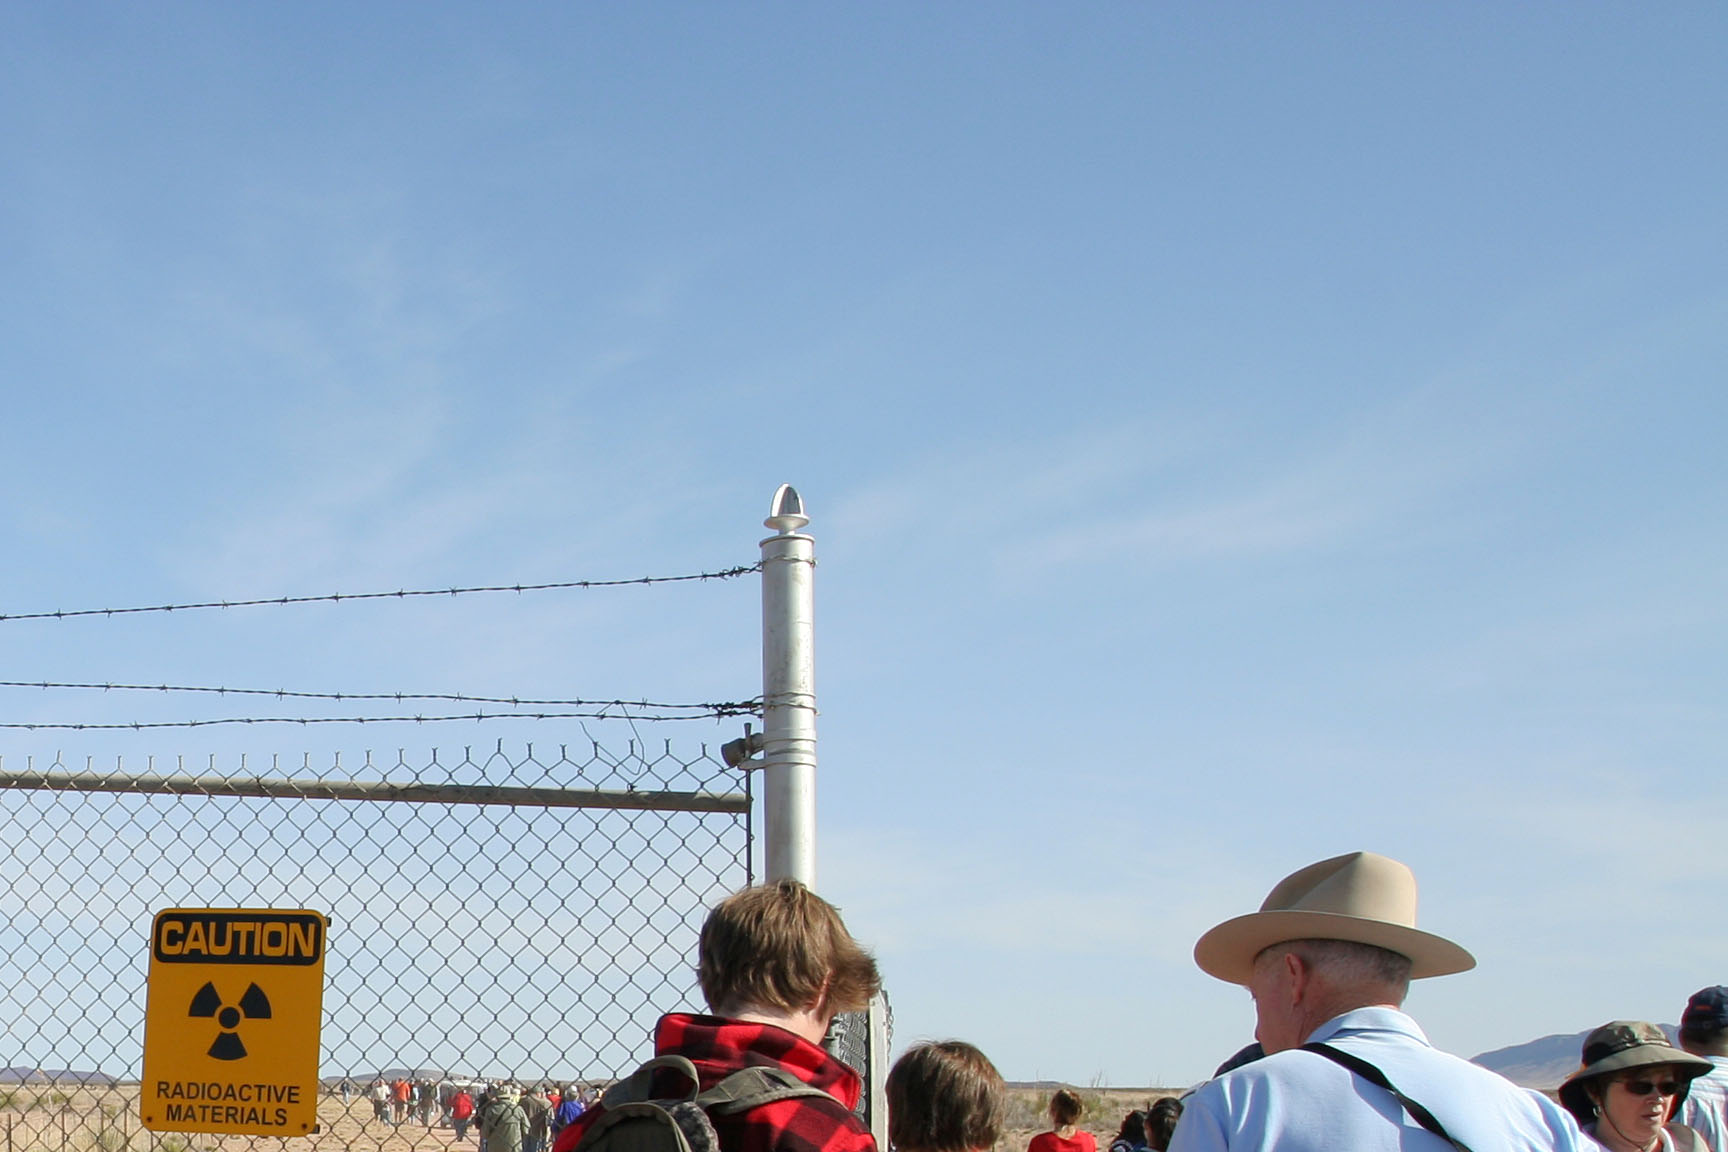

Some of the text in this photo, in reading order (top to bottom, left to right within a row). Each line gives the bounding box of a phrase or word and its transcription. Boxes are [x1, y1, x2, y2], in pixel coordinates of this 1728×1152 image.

[160, 920, 315, 957] CAUTION
[156, 1081, 300, 1104] RADIOACTIVE
[165, 1104, 287, 1126] MATERIALS
